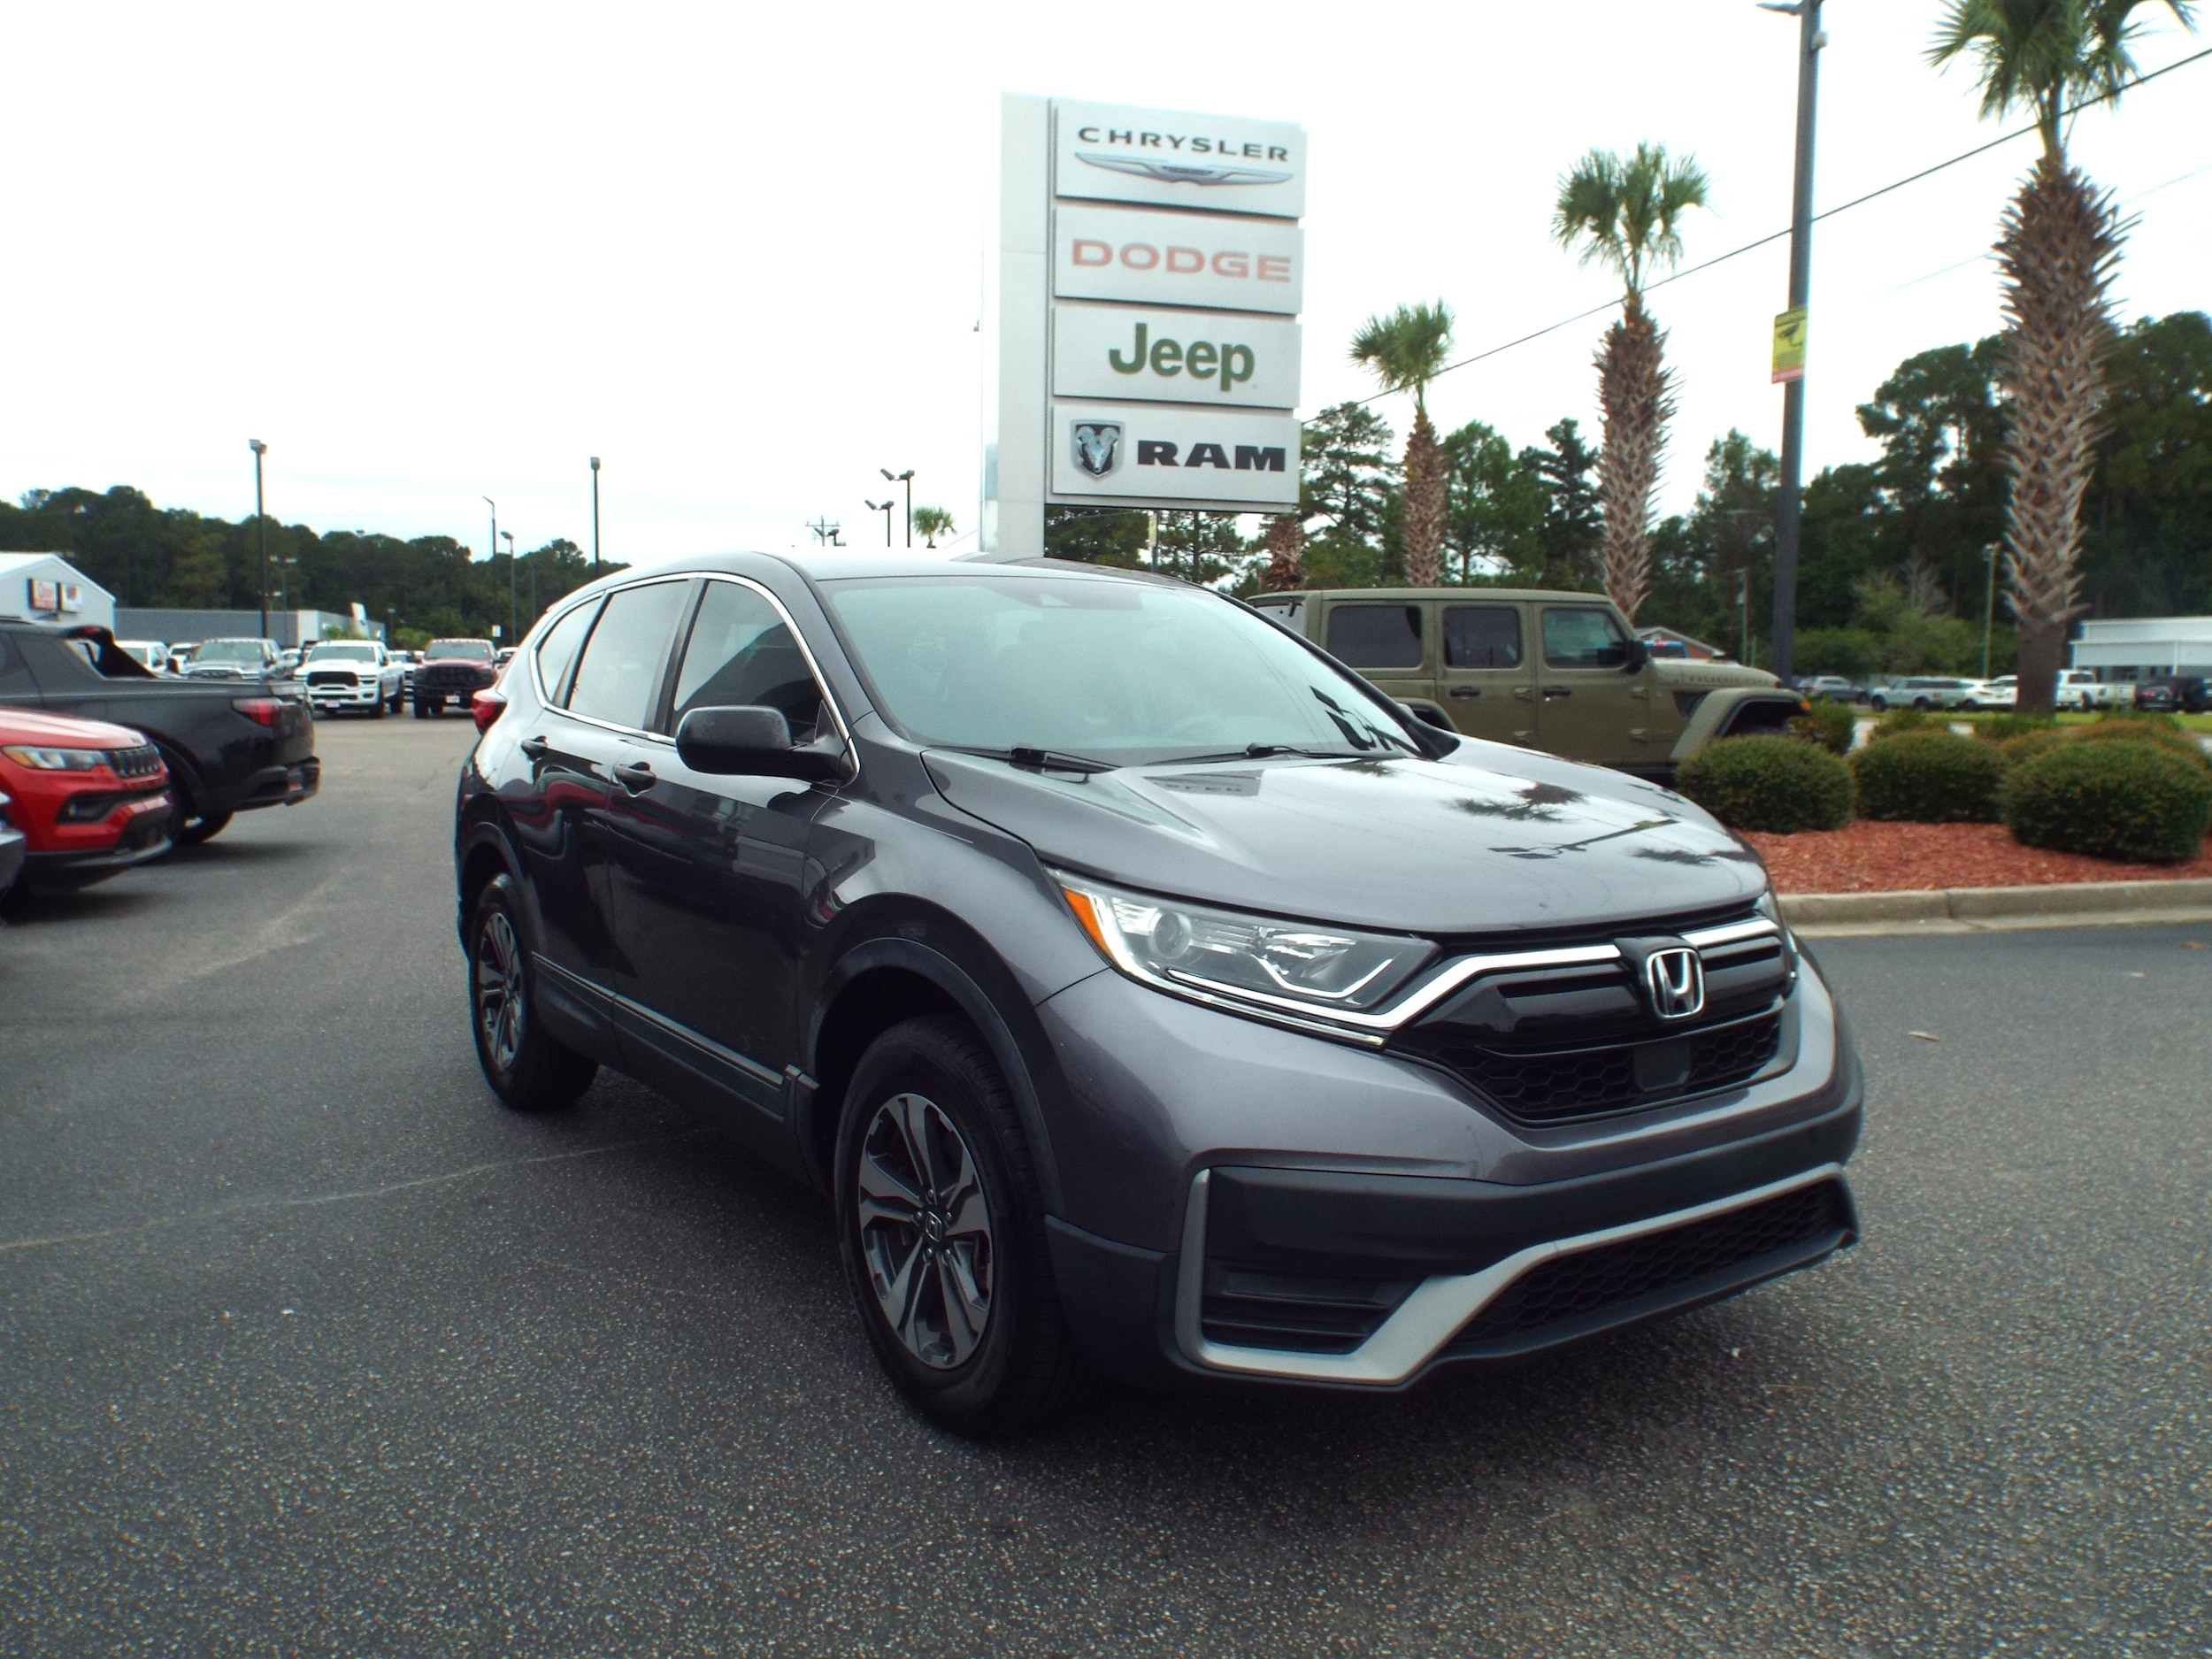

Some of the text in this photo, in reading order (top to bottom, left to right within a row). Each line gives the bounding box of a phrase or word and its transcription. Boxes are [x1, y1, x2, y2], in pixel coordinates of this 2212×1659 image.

[1079, 127, 1289, 161] CHRYSLER
[1071, 239, 1291, 282] DODGE
[1109, 322, 1255, 391] Jeep
[1138, 440, 1286, 472] RAM
